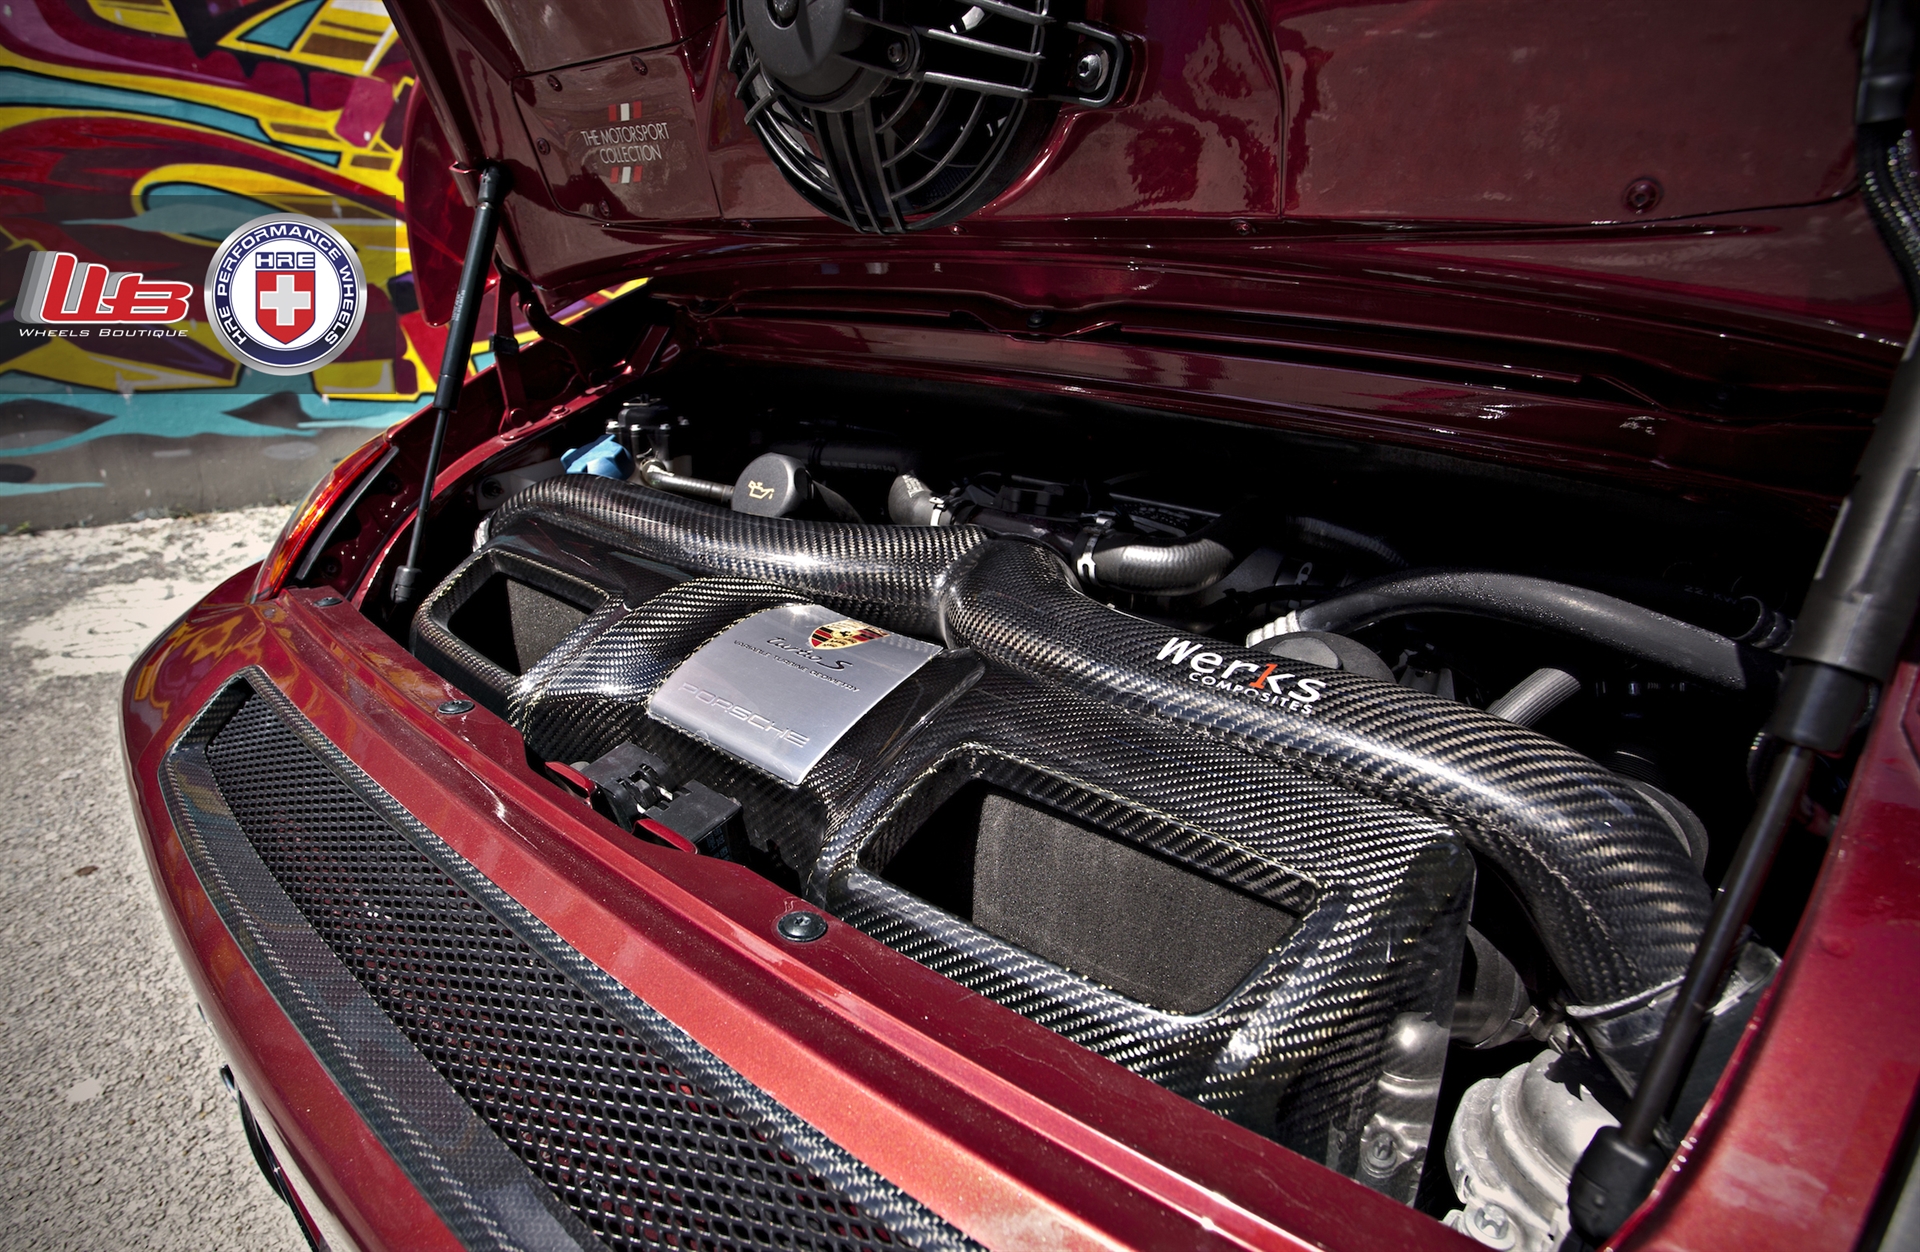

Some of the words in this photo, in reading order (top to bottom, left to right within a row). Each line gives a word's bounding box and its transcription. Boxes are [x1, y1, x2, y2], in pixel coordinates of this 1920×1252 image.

[581, 130, 601, 146] THE
[600, 122, 670, 145] MOTORSPORT
[600, 144, 662, 164] COLLECTION
[733, 639, 773, 658] VARIABLE
[773, 654, 809, 673] TURBINE
[809, 670, 860, 693] GEOMETRY
[766, 636, 823, 662] turbo
[816, 660, 854, 672] S
[1189, 672, 1313, 715] COMPOSITES
[678, 682, 811, 748] PORSCHE
